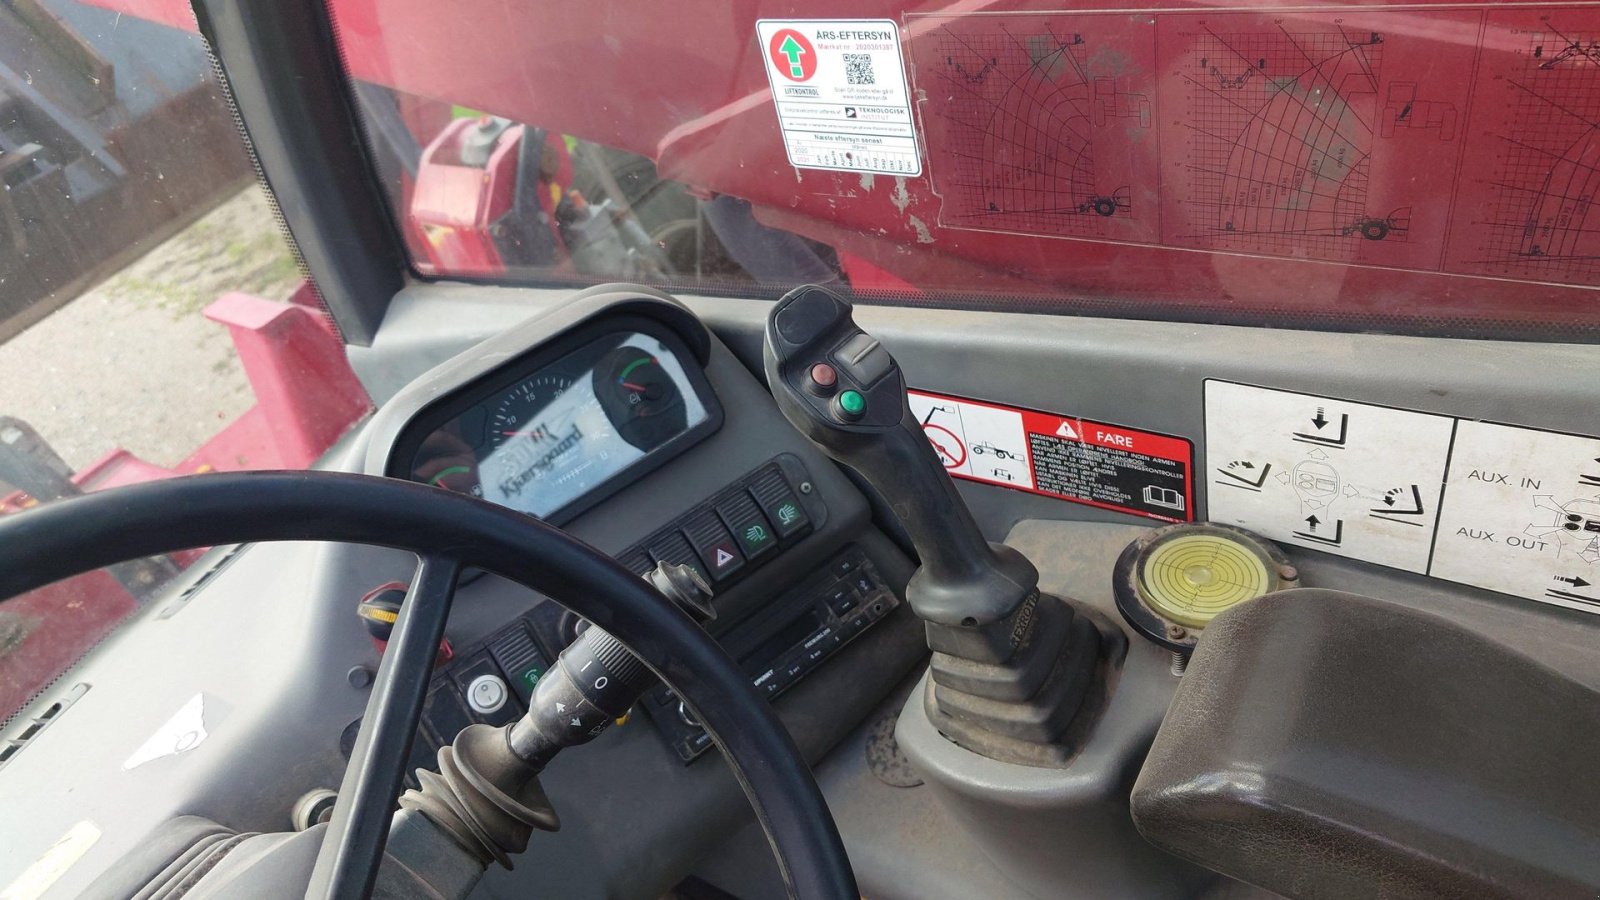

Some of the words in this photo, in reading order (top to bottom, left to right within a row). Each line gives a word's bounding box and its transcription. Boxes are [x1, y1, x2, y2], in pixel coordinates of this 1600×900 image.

[816, 30, 892, 41] ÅRS-EFTERSYN
[784, 88, 819, 96] LIFTKONTROL
[859, 107, 905, 115] TEKNOLOGISK
[525, 393, 536, 403] 15
[506, 415, 517, 425] 10
[1097, 431, 1133, 448] FARE
[1030, 433, 1058, 442] MASKINEN
[1096, 446, 1128, 456] NIVELLERET
[1152, 457, 1175, 466] ARMEN
[1046, 452, 1066, 460] ARMEN
[1033, 455, 1061, 464] RAMMENS
[1063, 461, 1090, 470] POSITION
[1048, 463, 1068, 471] ARMEN
[1049, 468, 1078, 478] MASKINEN
[1468, 470, 1513, 486] AUX.
[1520, 478, 1541, 490] IN
[1093, 488, 1131, 499] OVERHOLDES
[1456, 527, 1499, 543] AUX.
[1506, 536, 1549, 551] OUT
